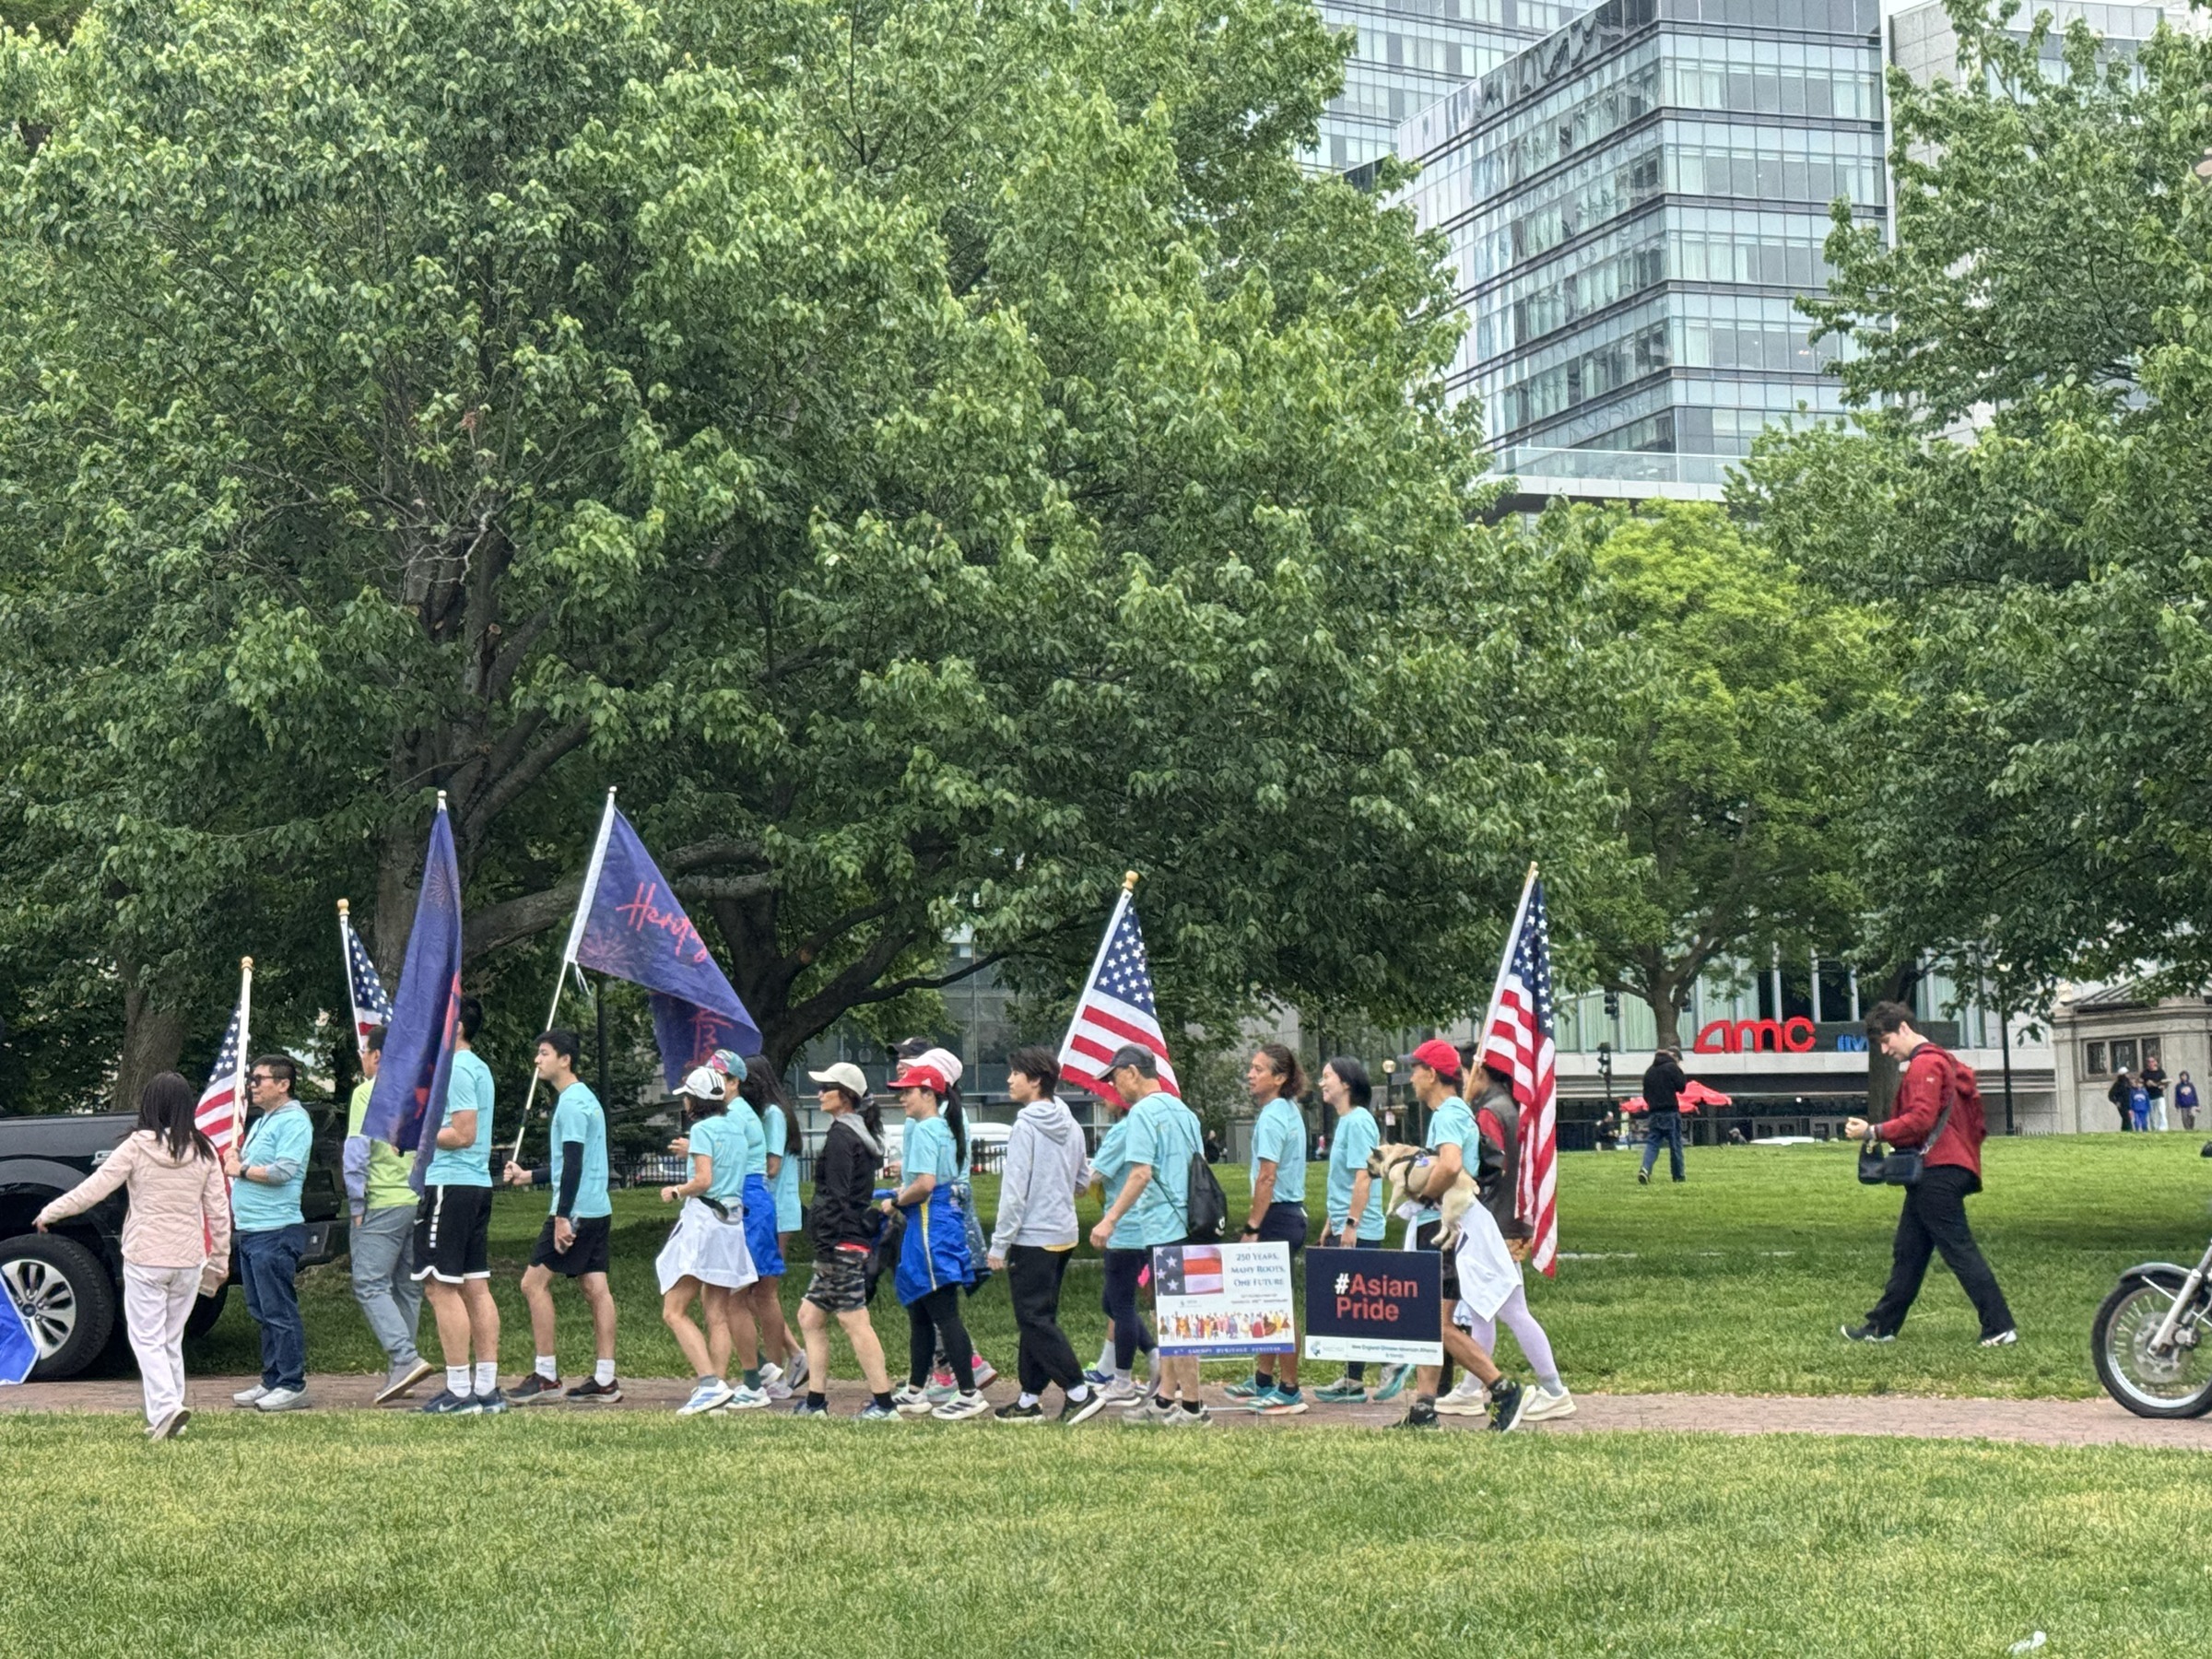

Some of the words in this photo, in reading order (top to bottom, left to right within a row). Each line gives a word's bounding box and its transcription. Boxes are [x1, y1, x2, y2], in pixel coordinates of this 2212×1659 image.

[1837, 1033, 1870, 1052] IM
[1236, 1253, 1251, 1262] 250
[1233, 1278, 1251, 1287] ONE
[1253, 1277, 1284, 1287] FUTURE
[1335, 1273, 1418, 1298] #Asian
[1336, 1296, 1399, 1322] Pride
